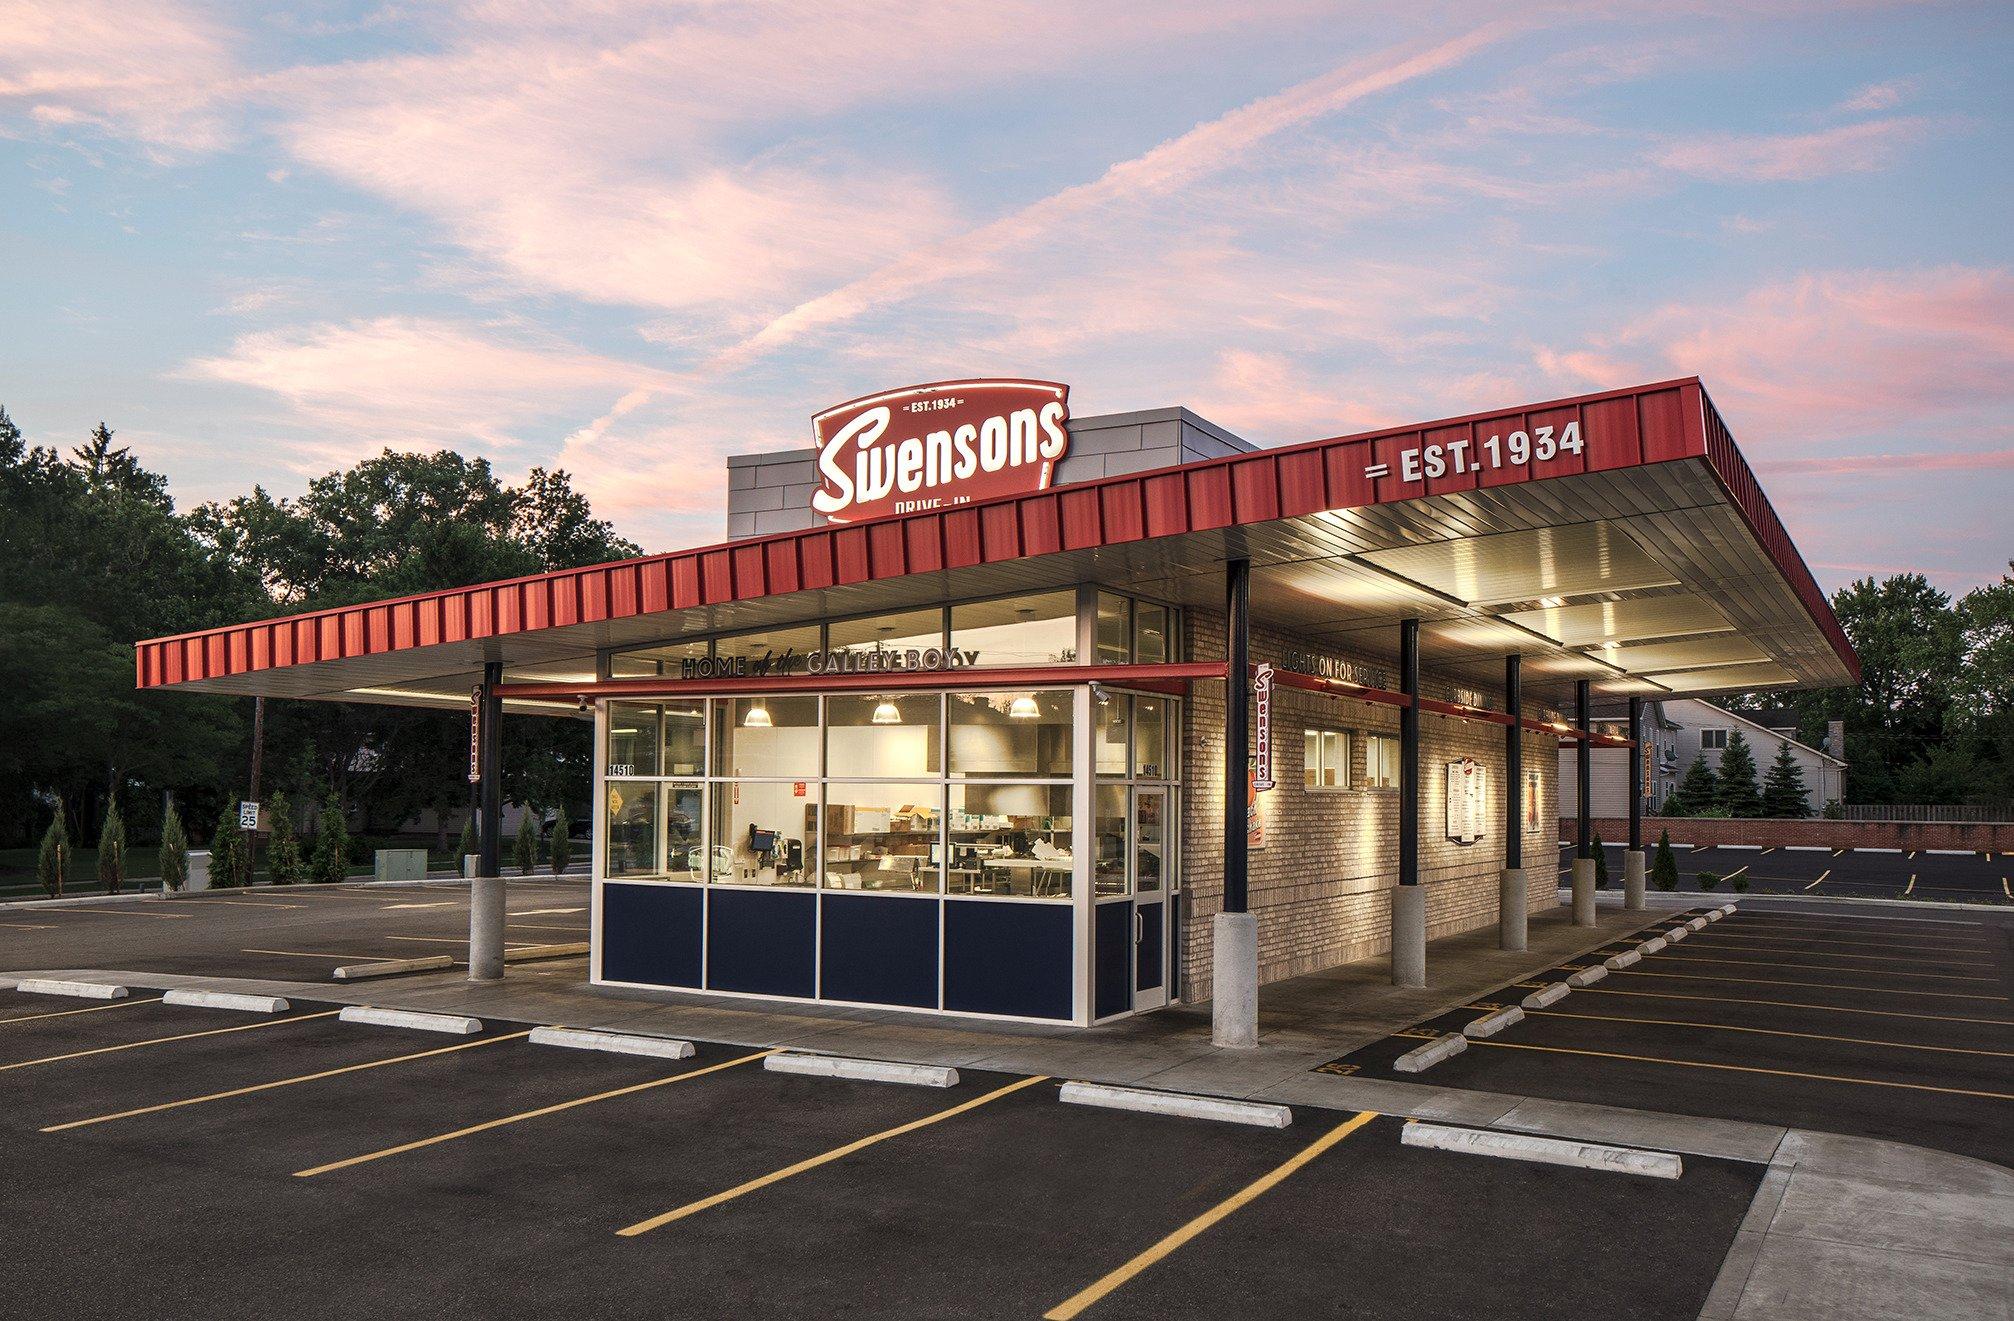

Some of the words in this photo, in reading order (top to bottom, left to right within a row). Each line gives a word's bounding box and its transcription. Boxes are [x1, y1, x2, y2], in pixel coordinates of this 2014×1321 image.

[812, 401, 1064, 513] Swensons
[681, 656, 746, 679] HOME
[806, 650, 897, 675] GALLEY
[906, 649, 957, 672] BOY
[1318, 656, 1333, 677] ON
[1335, 660, 1353, 682] FOR
[1254, 668, 1274, 779] Swensons
[609, 764, 635, 777] 14510
[241, 815, 256, 826] 25
